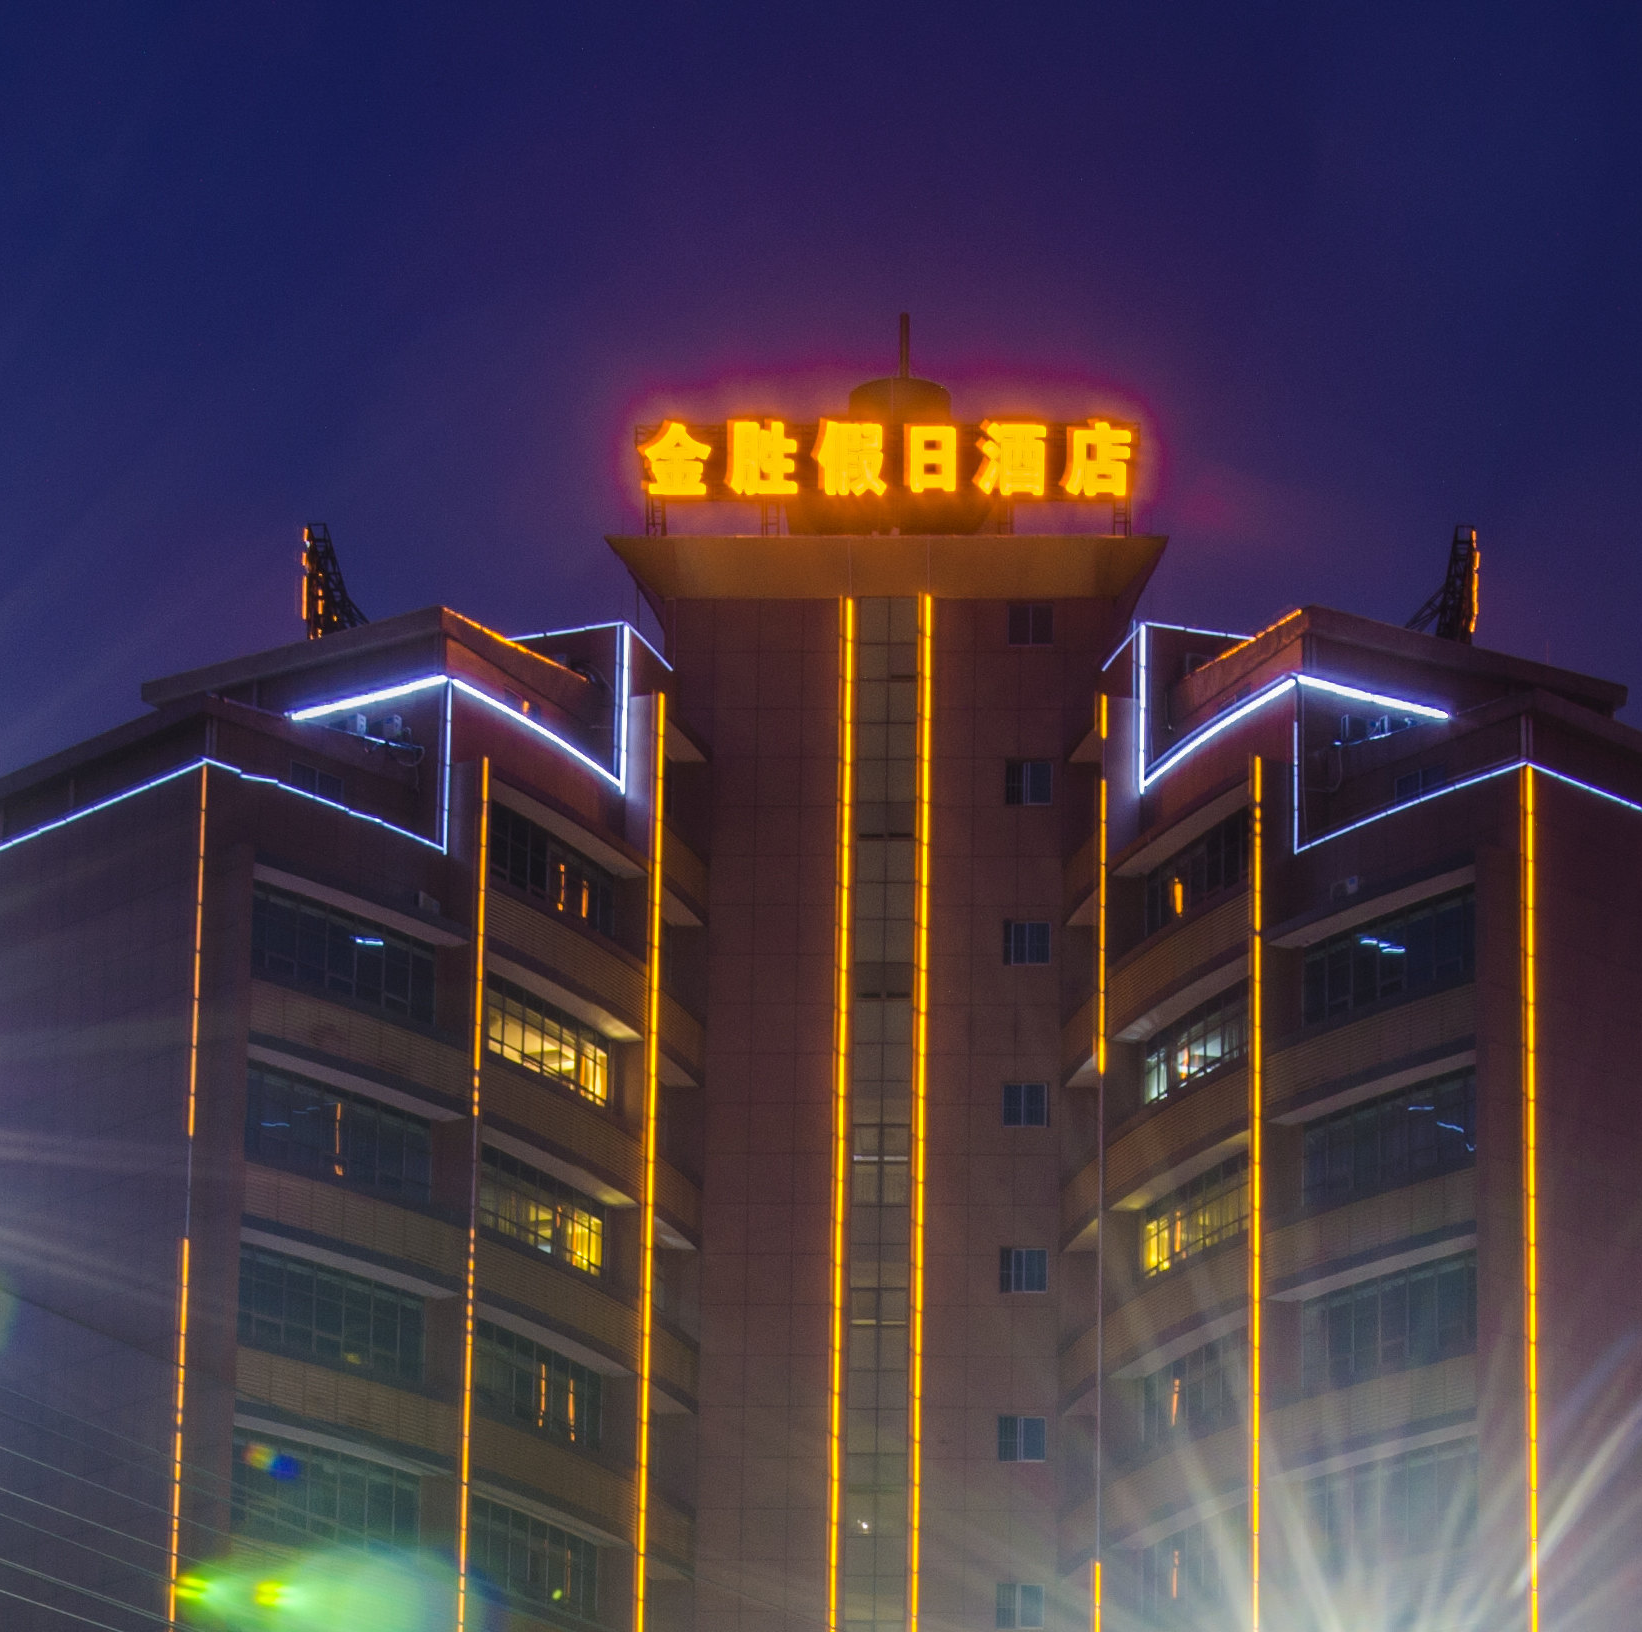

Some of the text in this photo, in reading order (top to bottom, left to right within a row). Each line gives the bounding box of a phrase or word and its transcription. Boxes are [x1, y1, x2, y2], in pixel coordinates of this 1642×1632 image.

[639, 419, 1133, 497] 金胜假日酒店
